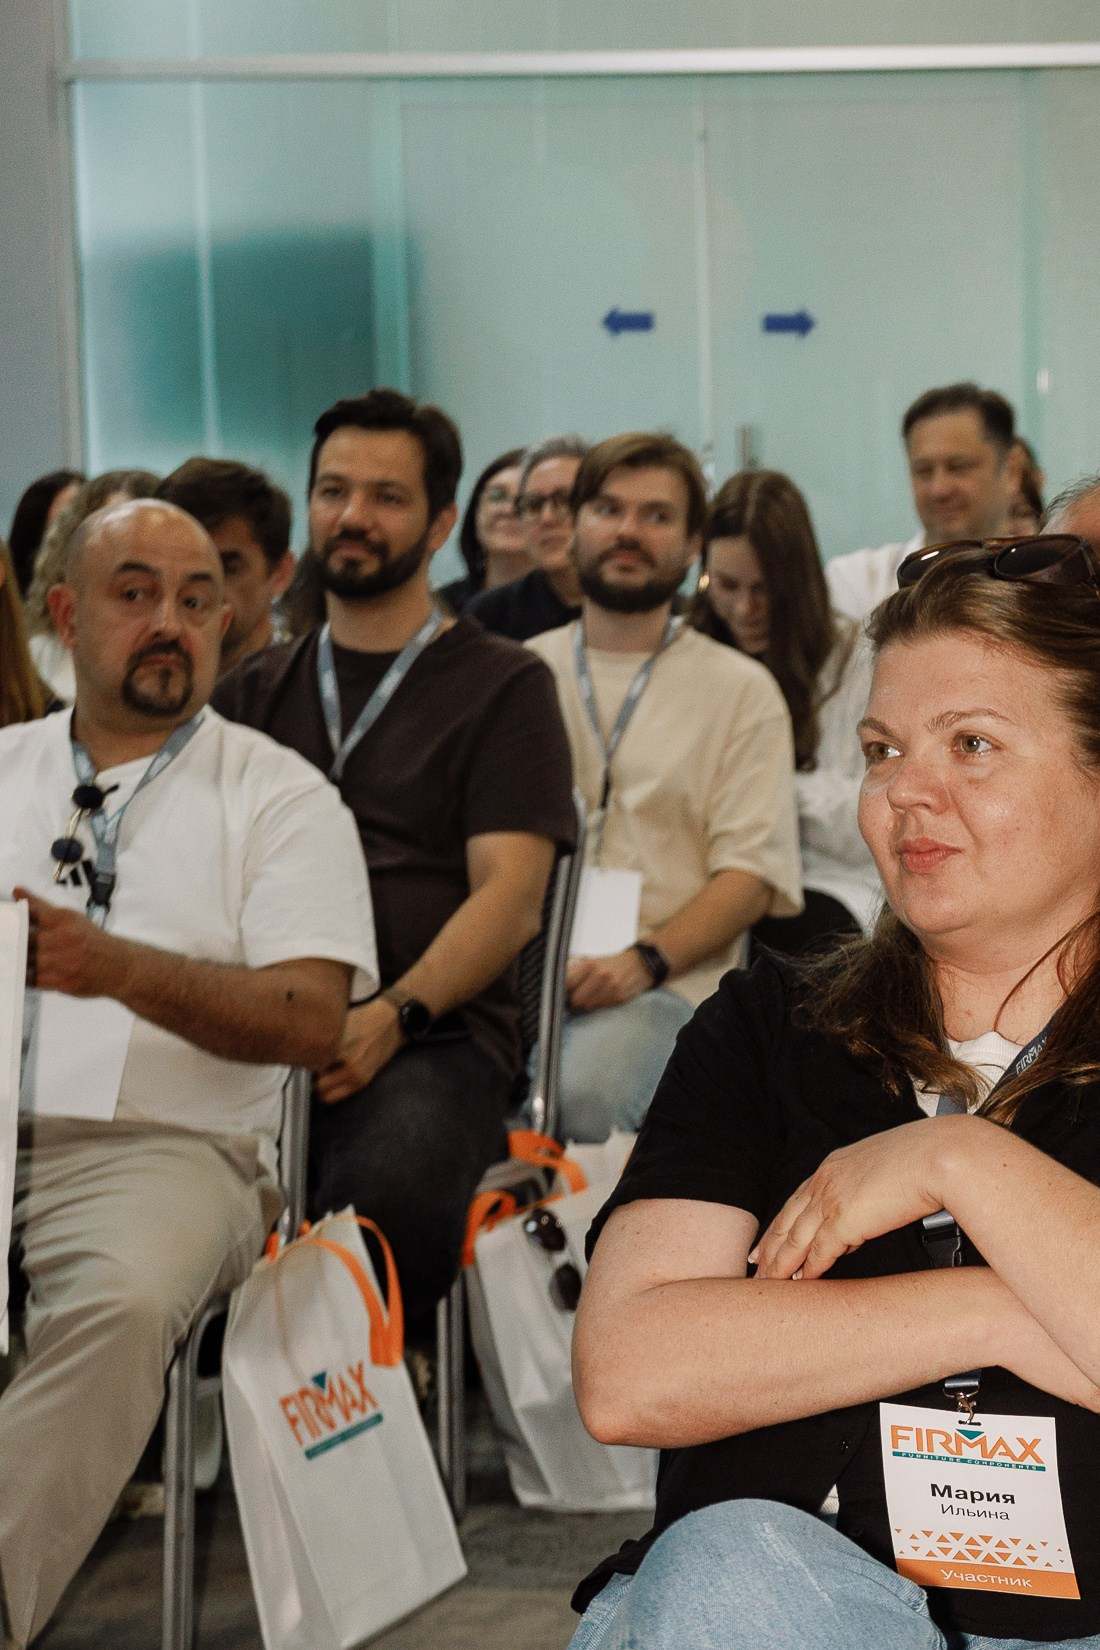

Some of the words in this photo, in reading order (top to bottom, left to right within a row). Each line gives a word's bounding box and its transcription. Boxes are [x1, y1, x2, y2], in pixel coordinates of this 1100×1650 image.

[279, 1360, 379, 1447] FIRMAX
[890, 1424, 1045, 1465] FIRMAX
[901, 1452, 962, 1464] FURNITURE
[967, 1459, 1038, 1471] COMPONENTS
[930, 1483, 1016, 1505] Мария
[940, 1503, 1010, 1521] Ильина
[940, 1569, 1033, 1588] Участник
